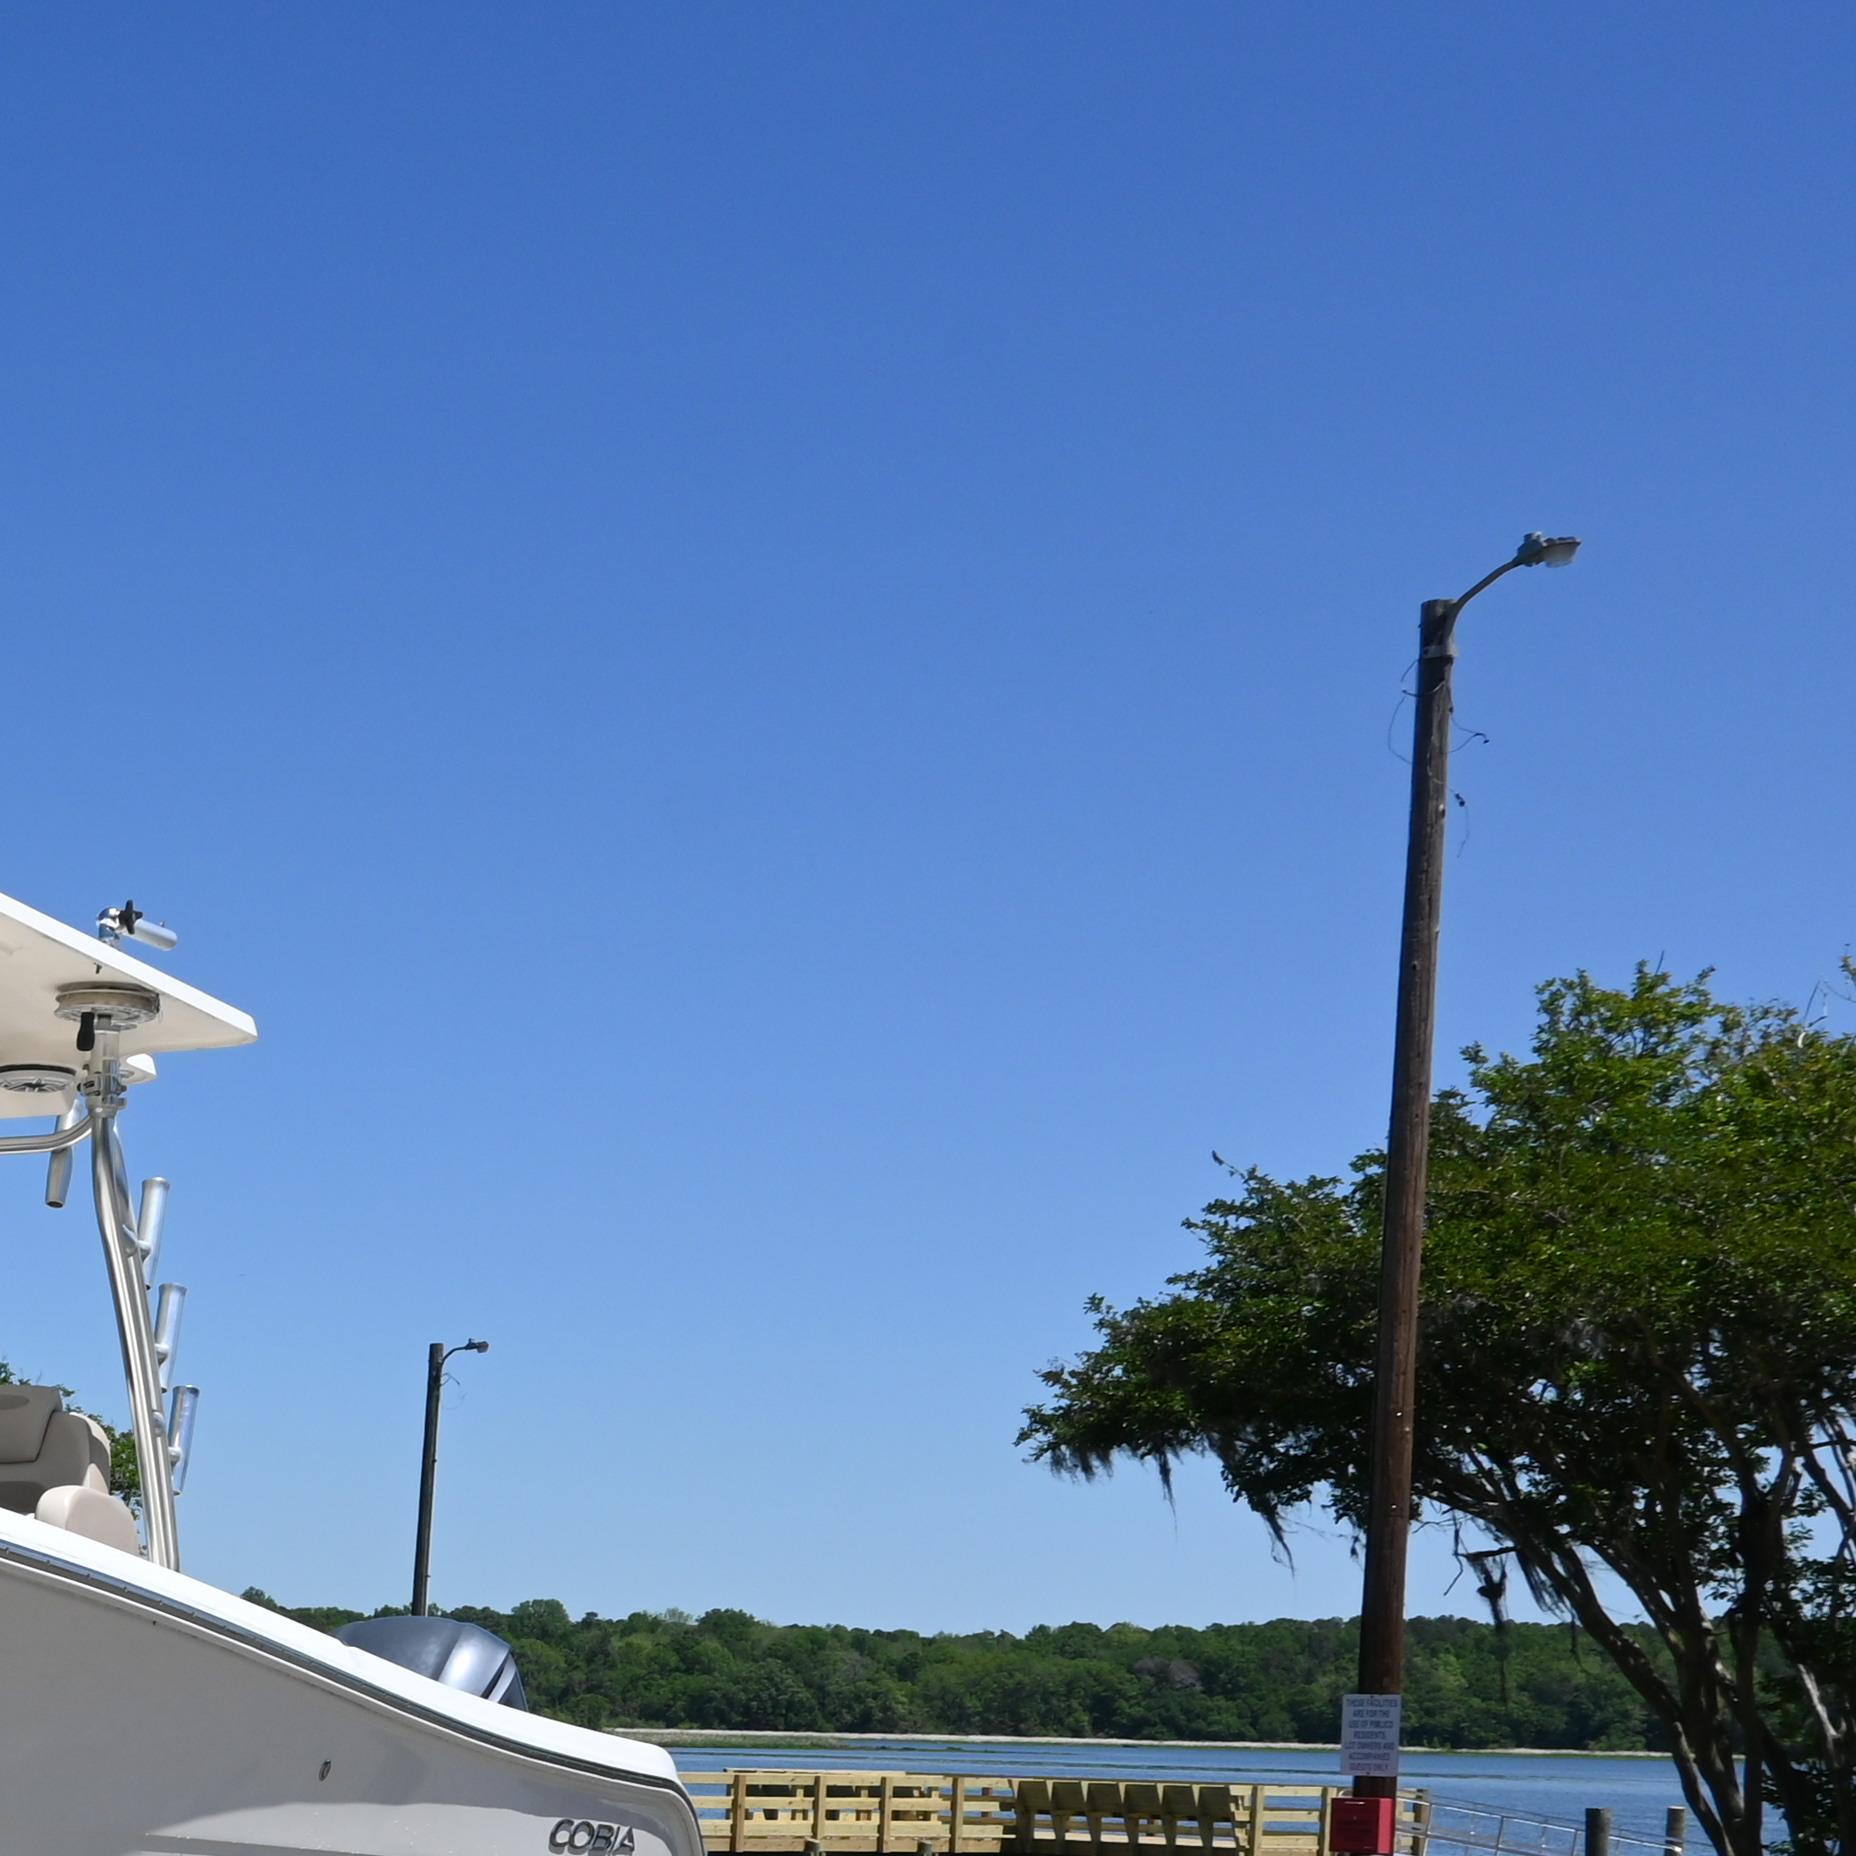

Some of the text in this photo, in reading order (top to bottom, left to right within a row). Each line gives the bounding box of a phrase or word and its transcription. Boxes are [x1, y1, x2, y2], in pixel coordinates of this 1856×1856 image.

[1353, 1710, 1390, 1718] ARE FOR THE
[1348, 1720, 1360, 1729] USE
[549, 1818, 635, 1852] COBIA
